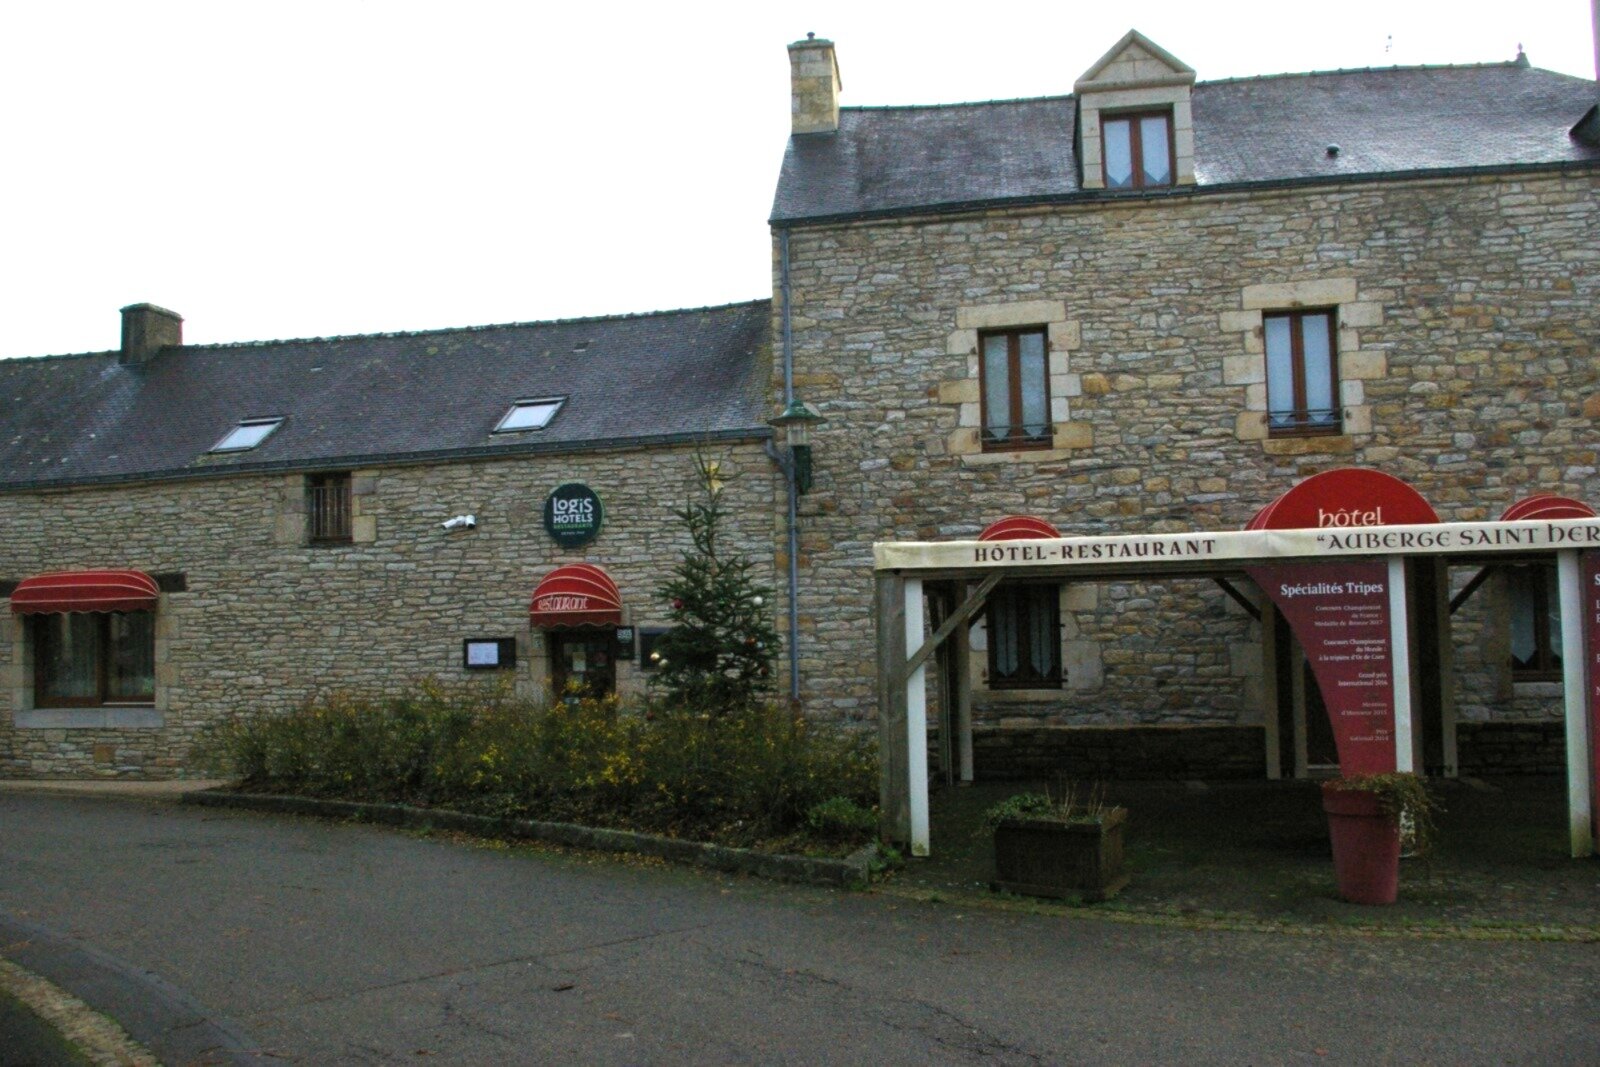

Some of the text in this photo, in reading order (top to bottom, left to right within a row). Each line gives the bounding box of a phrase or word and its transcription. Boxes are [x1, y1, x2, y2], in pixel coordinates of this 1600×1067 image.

[553, 513, 593, 524] HOTELS
[1318, 506, 1386, 528] hôtel
[1459, 527, 1539, 546] SAINT
[974, 539, 1216, 562] HÔTEL-RESTAURANT
[1280, 581, 1384, 598] Spécialités Tripes
